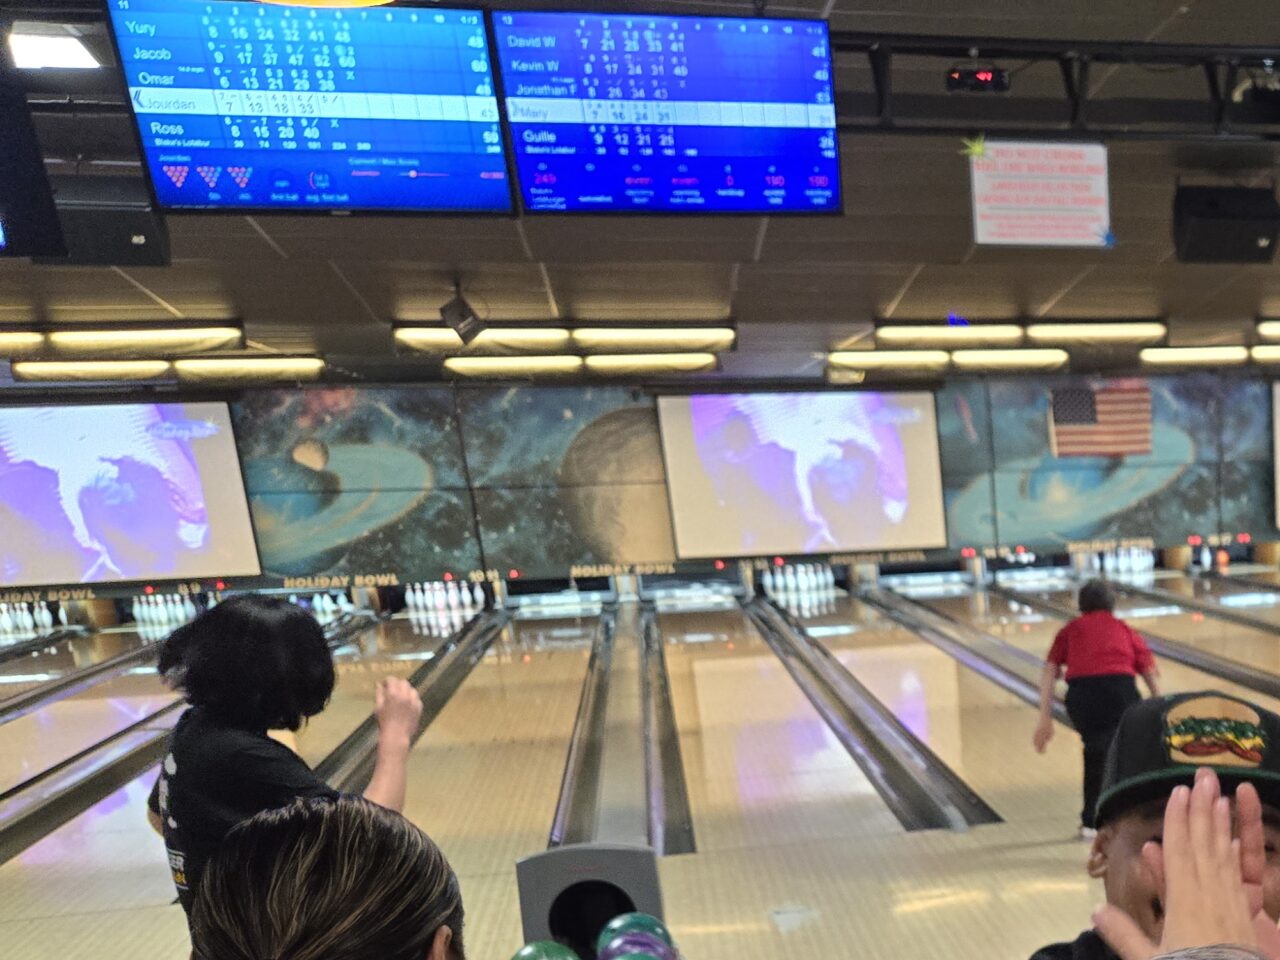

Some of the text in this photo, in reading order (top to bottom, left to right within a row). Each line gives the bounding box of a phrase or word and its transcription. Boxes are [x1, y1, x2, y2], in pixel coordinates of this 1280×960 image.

[125, 21, 156, 37] Yury
[232, 27, 248, 39] 16
[258, 29, 274, 40] 24
[284, 30, 300, 41] 32
[309, 31, 325, 42] 41
[507, 35, 556, 48] David W
[133, 47, 171, 61] Jacob
[214, 51, 224, 64] 9
[237, 53, 252, 64] 17
[263, 54, 278, 65] 37
[512, 60, 559, 72] Kevin W
[605, 64, 618, 75] 17
[138, 72, 175, 86] Omar
[220, 77, 230, 88] 6
[243, 77, 259, 89] 13
[268, 78, 284, 90] 21
[516, 84, 568, 96] Jonathan
[146, 98, 195, 110] Jourdan
[151, 122, 184, 135] Ross
[231, 125, 241, 138] 8
[253, 126, 269, 138] 15
[283, 573, 399, 588] HOLIDAY BOWL
[47, 588, 96, 601] BOWL
